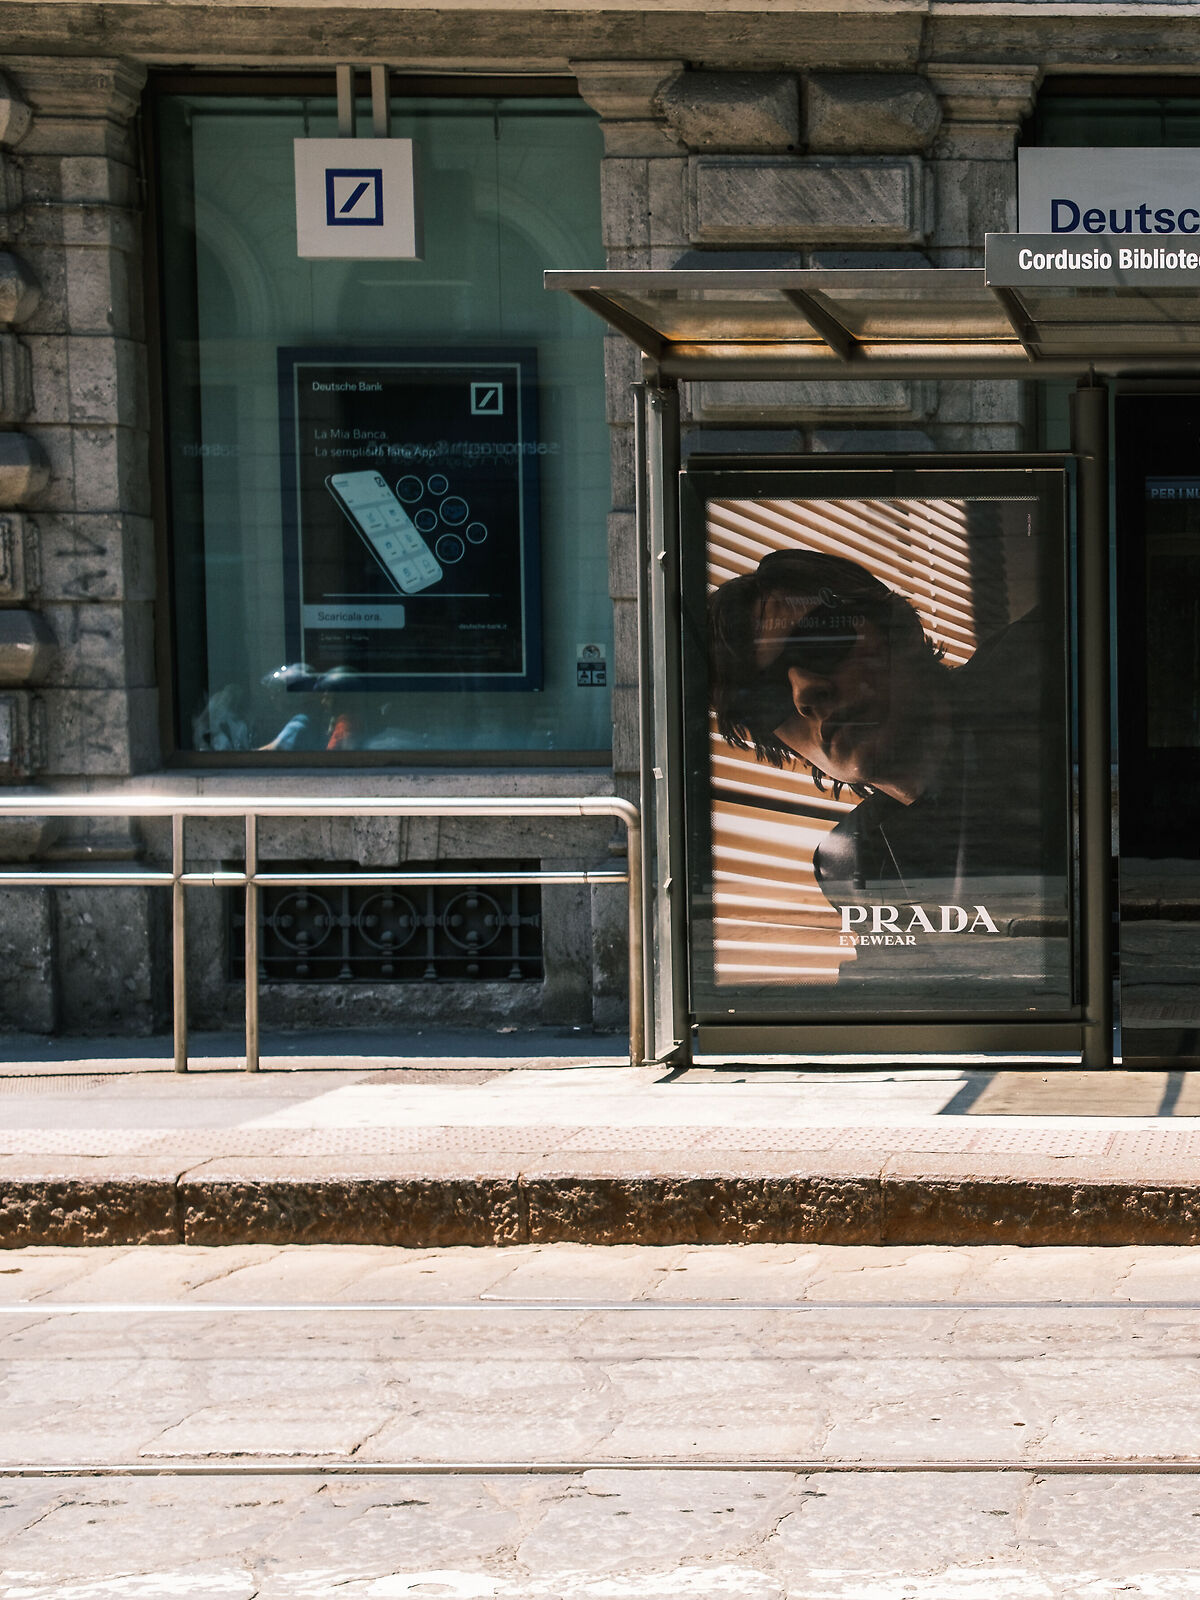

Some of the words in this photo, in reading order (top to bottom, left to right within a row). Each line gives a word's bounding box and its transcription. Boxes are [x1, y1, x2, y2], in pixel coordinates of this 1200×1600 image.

[1018, 248, 1113, 270] Cordusio
[312, 381, 357, 391] Deutsche
[358, 381, 383, 391] Bank
[314, 429, 327, 439] La
[330, 429, 350, 439] Mia
[315, 447, 327, 457] La
[1151, 488, 1175, 499] PER
[1178, 488, 1183, 499] I
[318, 611, 362, 621] Scaricala
[364, 612, 383, 621] ora.
[838, 905, 1000, 933] PRADA
[839, 935, 917, 946] EYEWEAR
